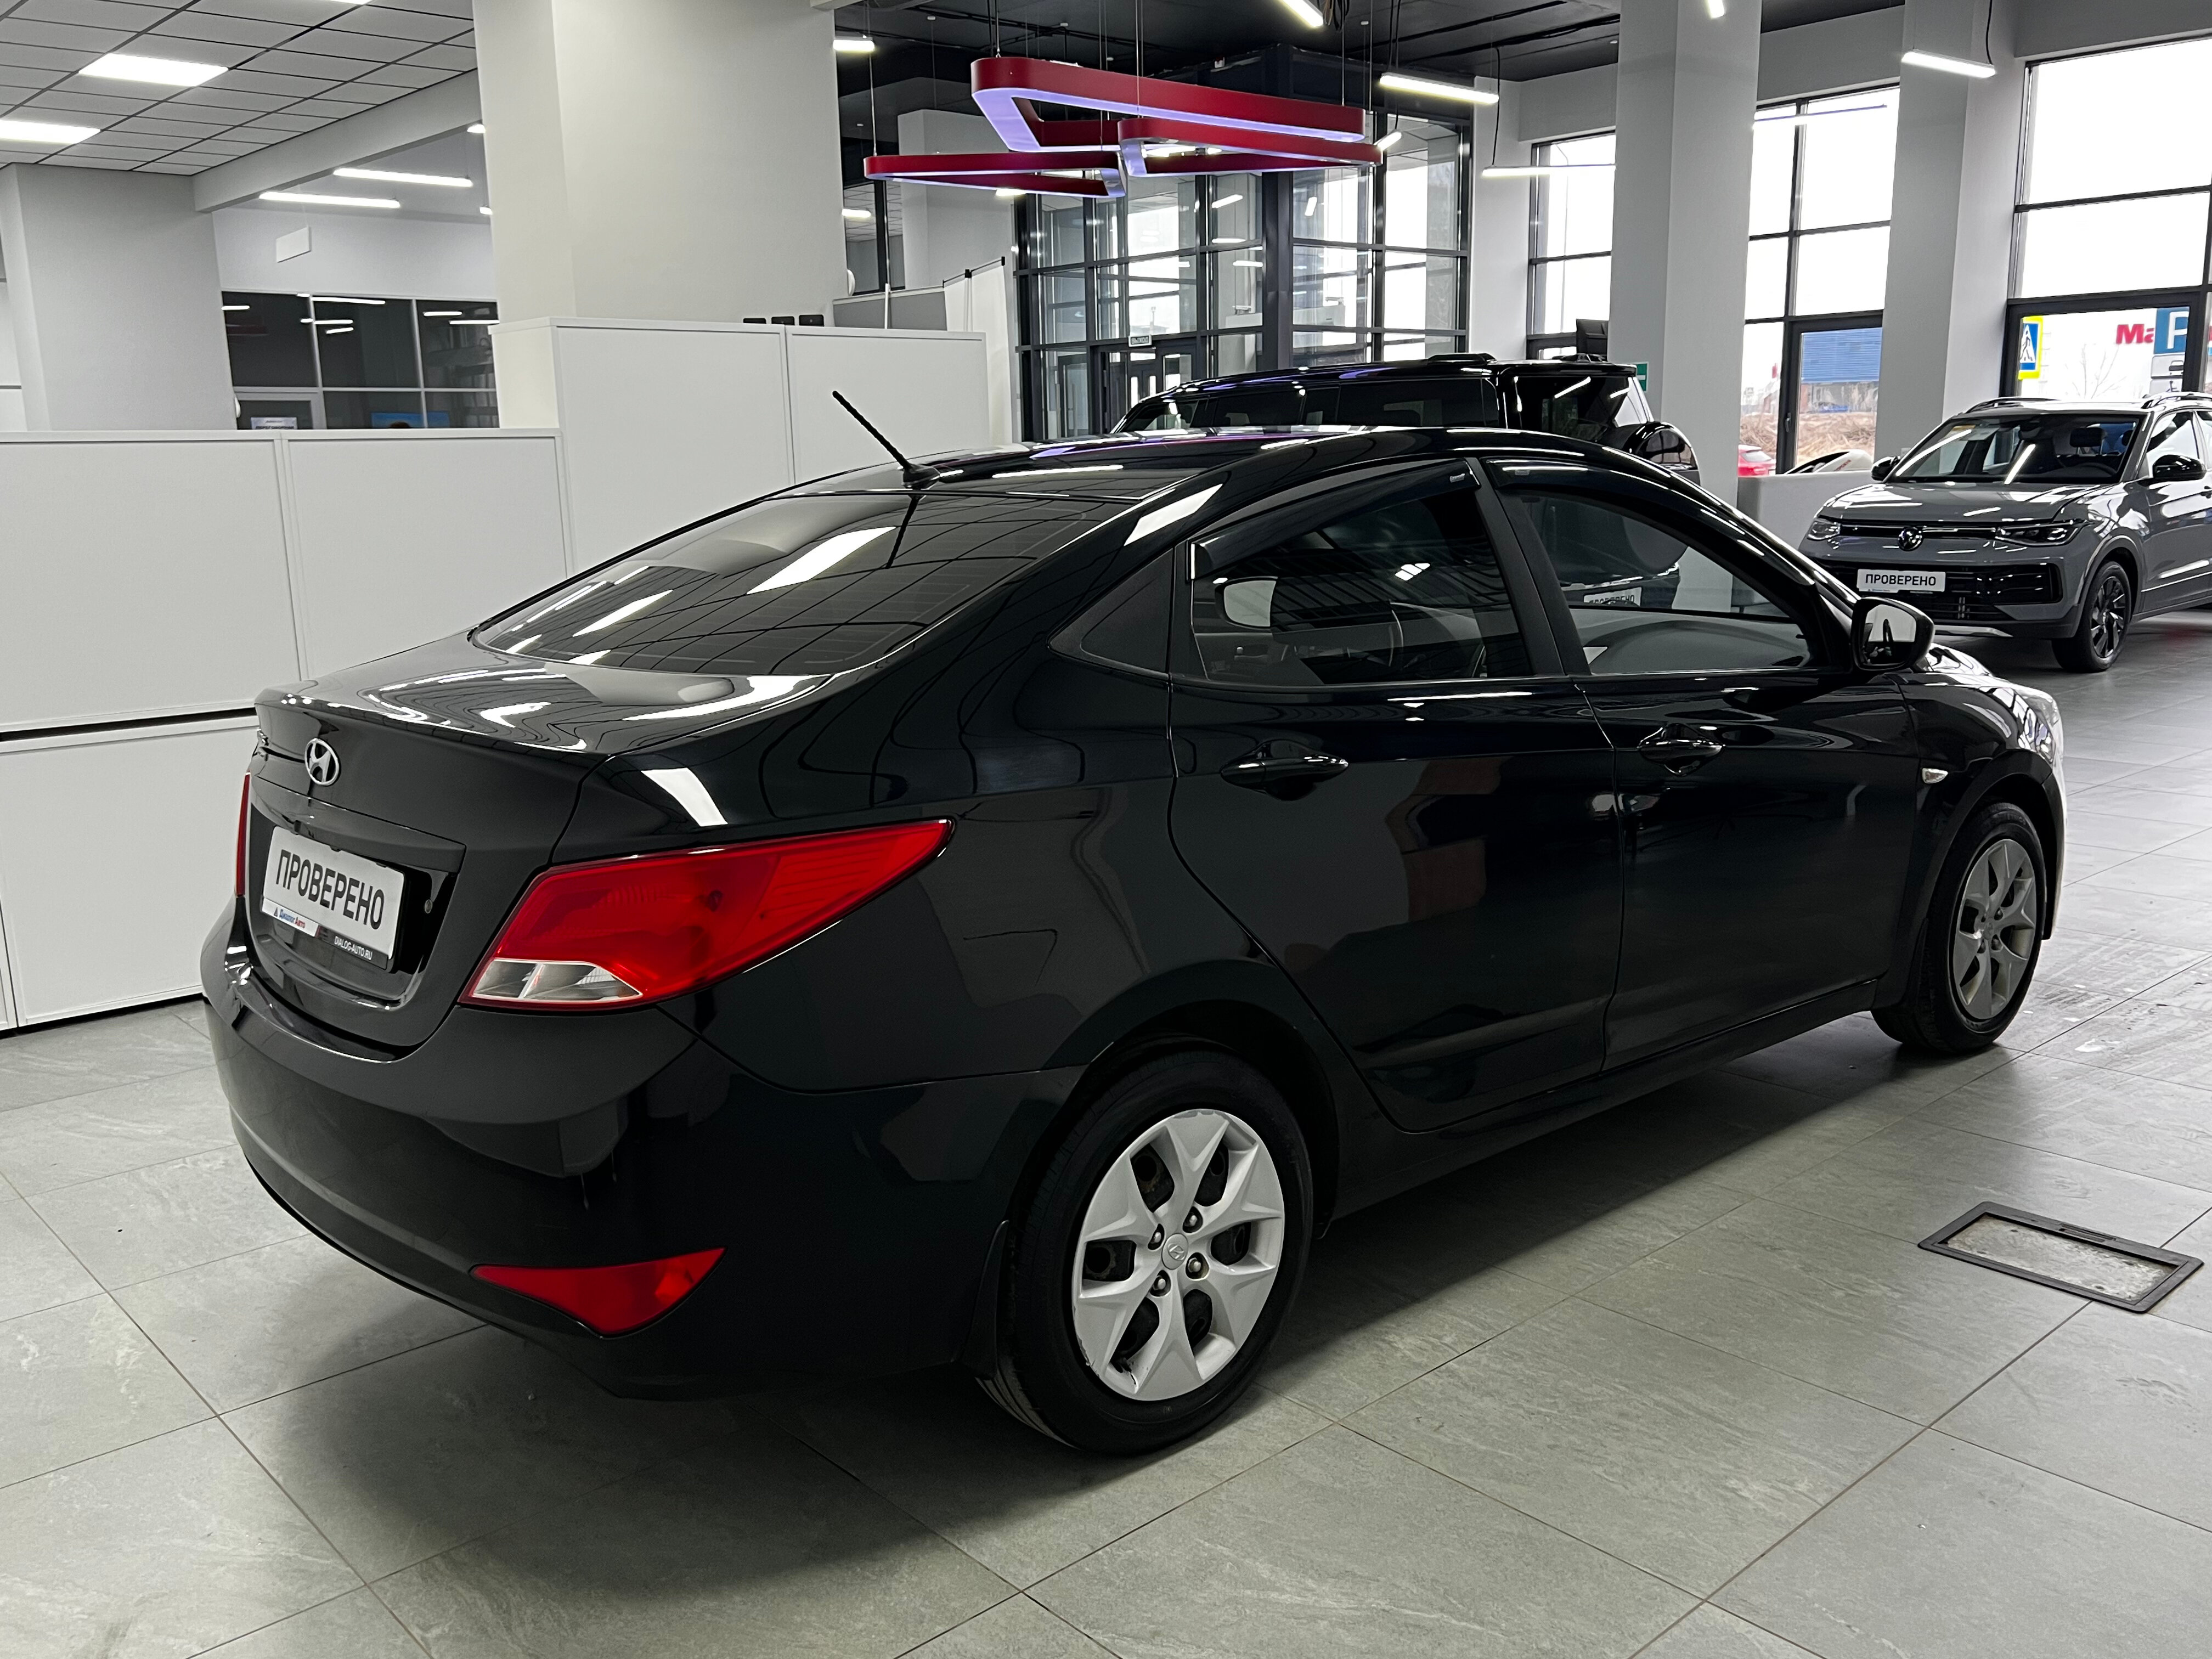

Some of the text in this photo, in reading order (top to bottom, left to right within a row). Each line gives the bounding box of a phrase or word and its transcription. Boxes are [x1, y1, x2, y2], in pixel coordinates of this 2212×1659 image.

[1865, 574, 1936, 586] ПРОВЕРЕНО
[275, 849, 385, 929] ПРОВЕРЕНО
[334, 935, 373, 960] DIALOG-AUTO.RU
